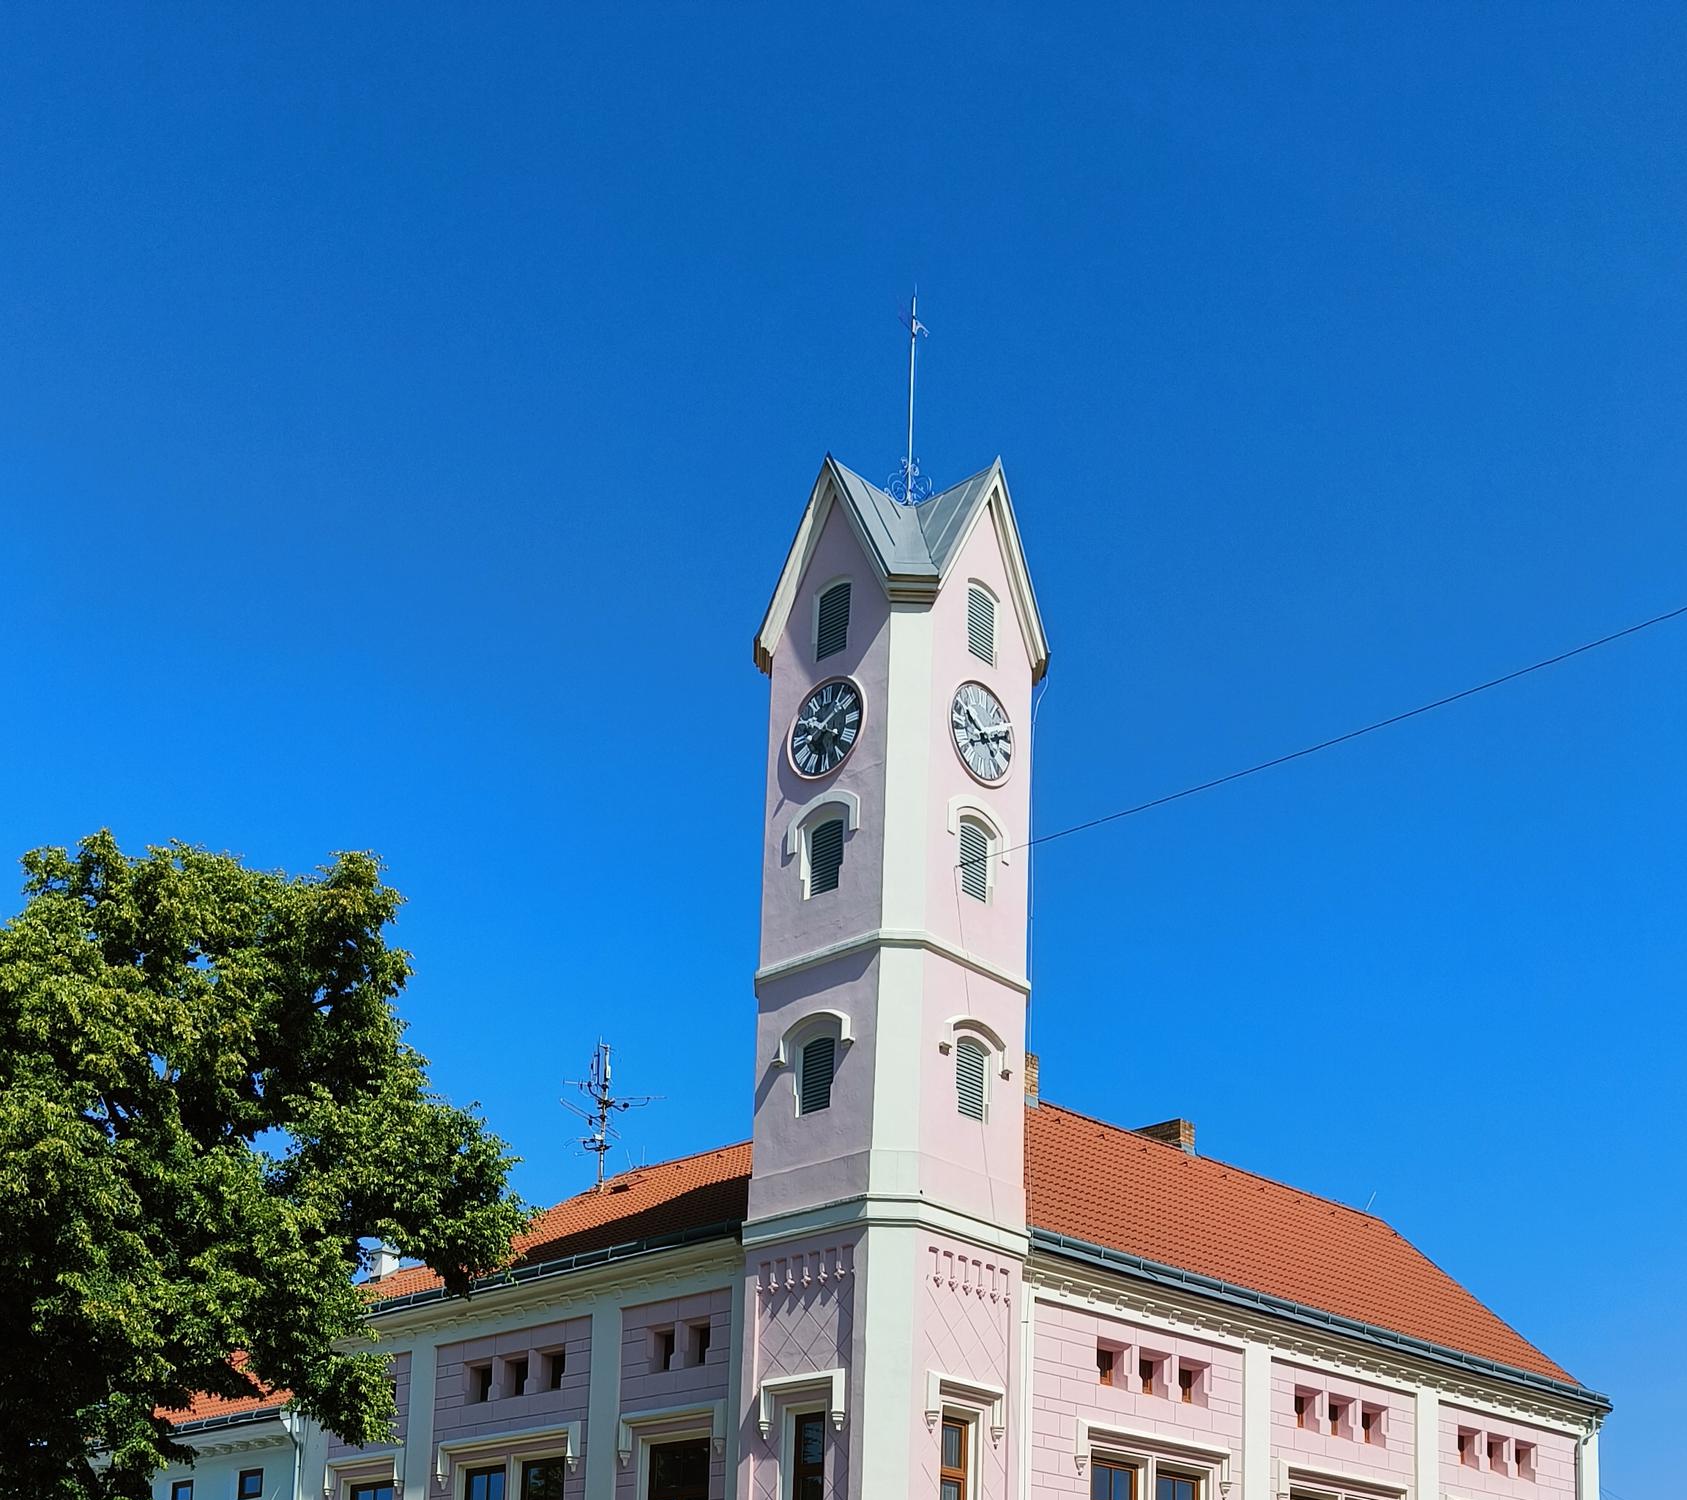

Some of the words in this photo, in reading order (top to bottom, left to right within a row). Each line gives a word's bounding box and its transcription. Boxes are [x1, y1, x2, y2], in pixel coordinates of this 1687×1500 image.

[822, 686, 833, 706] XII
[845, 710, 859, 724] III
[840, 727, 857, 745] IIII
